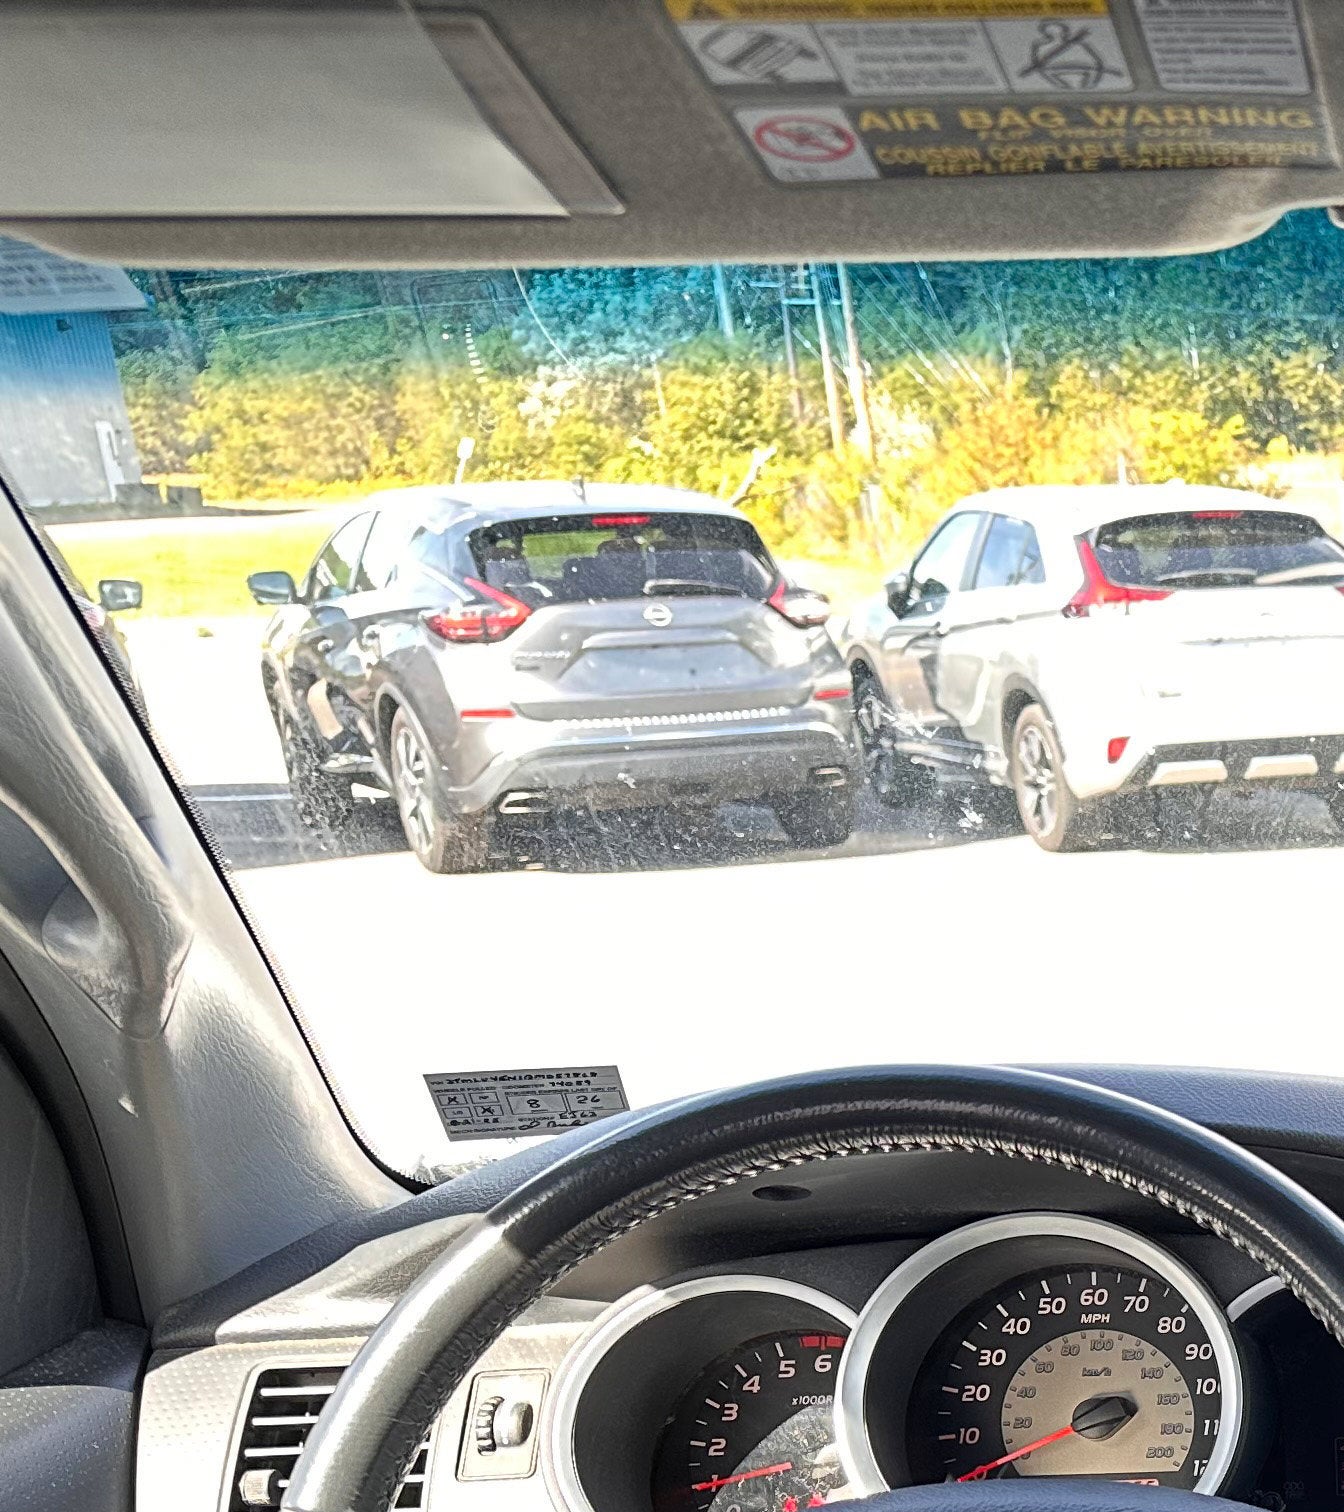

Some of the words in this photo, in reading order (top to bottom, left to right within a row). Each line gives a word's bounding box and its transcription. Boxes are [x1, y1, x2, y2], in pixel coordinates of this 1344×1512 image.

[859, 107, 939, 132] AIR
[959, 107, 1067, 130] BAG
[1086, 106, 1314, 129] WARNING
[1065, 158, 1099, 171] LE
[526, 1098, 541, 1109] 8
[576, 1094, 601, 1104] 26
[1080, 1288, 1108, 1306] 60
[1122, 1296, 1150, 1313] 70
[1037, 1297, 1066, 1315] 50
[1001, 1317, 1031, 1335] 40
[1080, 1313, 1111, 1324] MPH
[1157, 1316, 1186, 1334] 80
[1060, 1344, 1080, 1357] 80
[1090, 1338, 1114, 1351] 100
[1185, 1343, 1213, 1361] 90
[814, 1354, 832, 1373] 6
[977, 1349, 1007, 1366] 30
[1121, 1349, 1144, 1361] 120
[778, 1360, 796, 1378] 5
[1035, 1362, 1054, 1374] 60
[1140, 1367, 1164, 1379] 140
[742, 1375, 761, 1393] 4
[1016, 1385, 1036, 1398] 40
[1196, 1378, 1221, 1395] 10
[961, 1384, 990, 1402] 20
[1157, 1392, 1181, 1406] 160
[721, 1403, 739, 1422] 3
[1012, 1416, 1033, 1429] 20
[959, 1427, 981, 1445] 10
[708, 1438, 727, 1456] 2
[1145, 1446, 1175, 1459] 200
